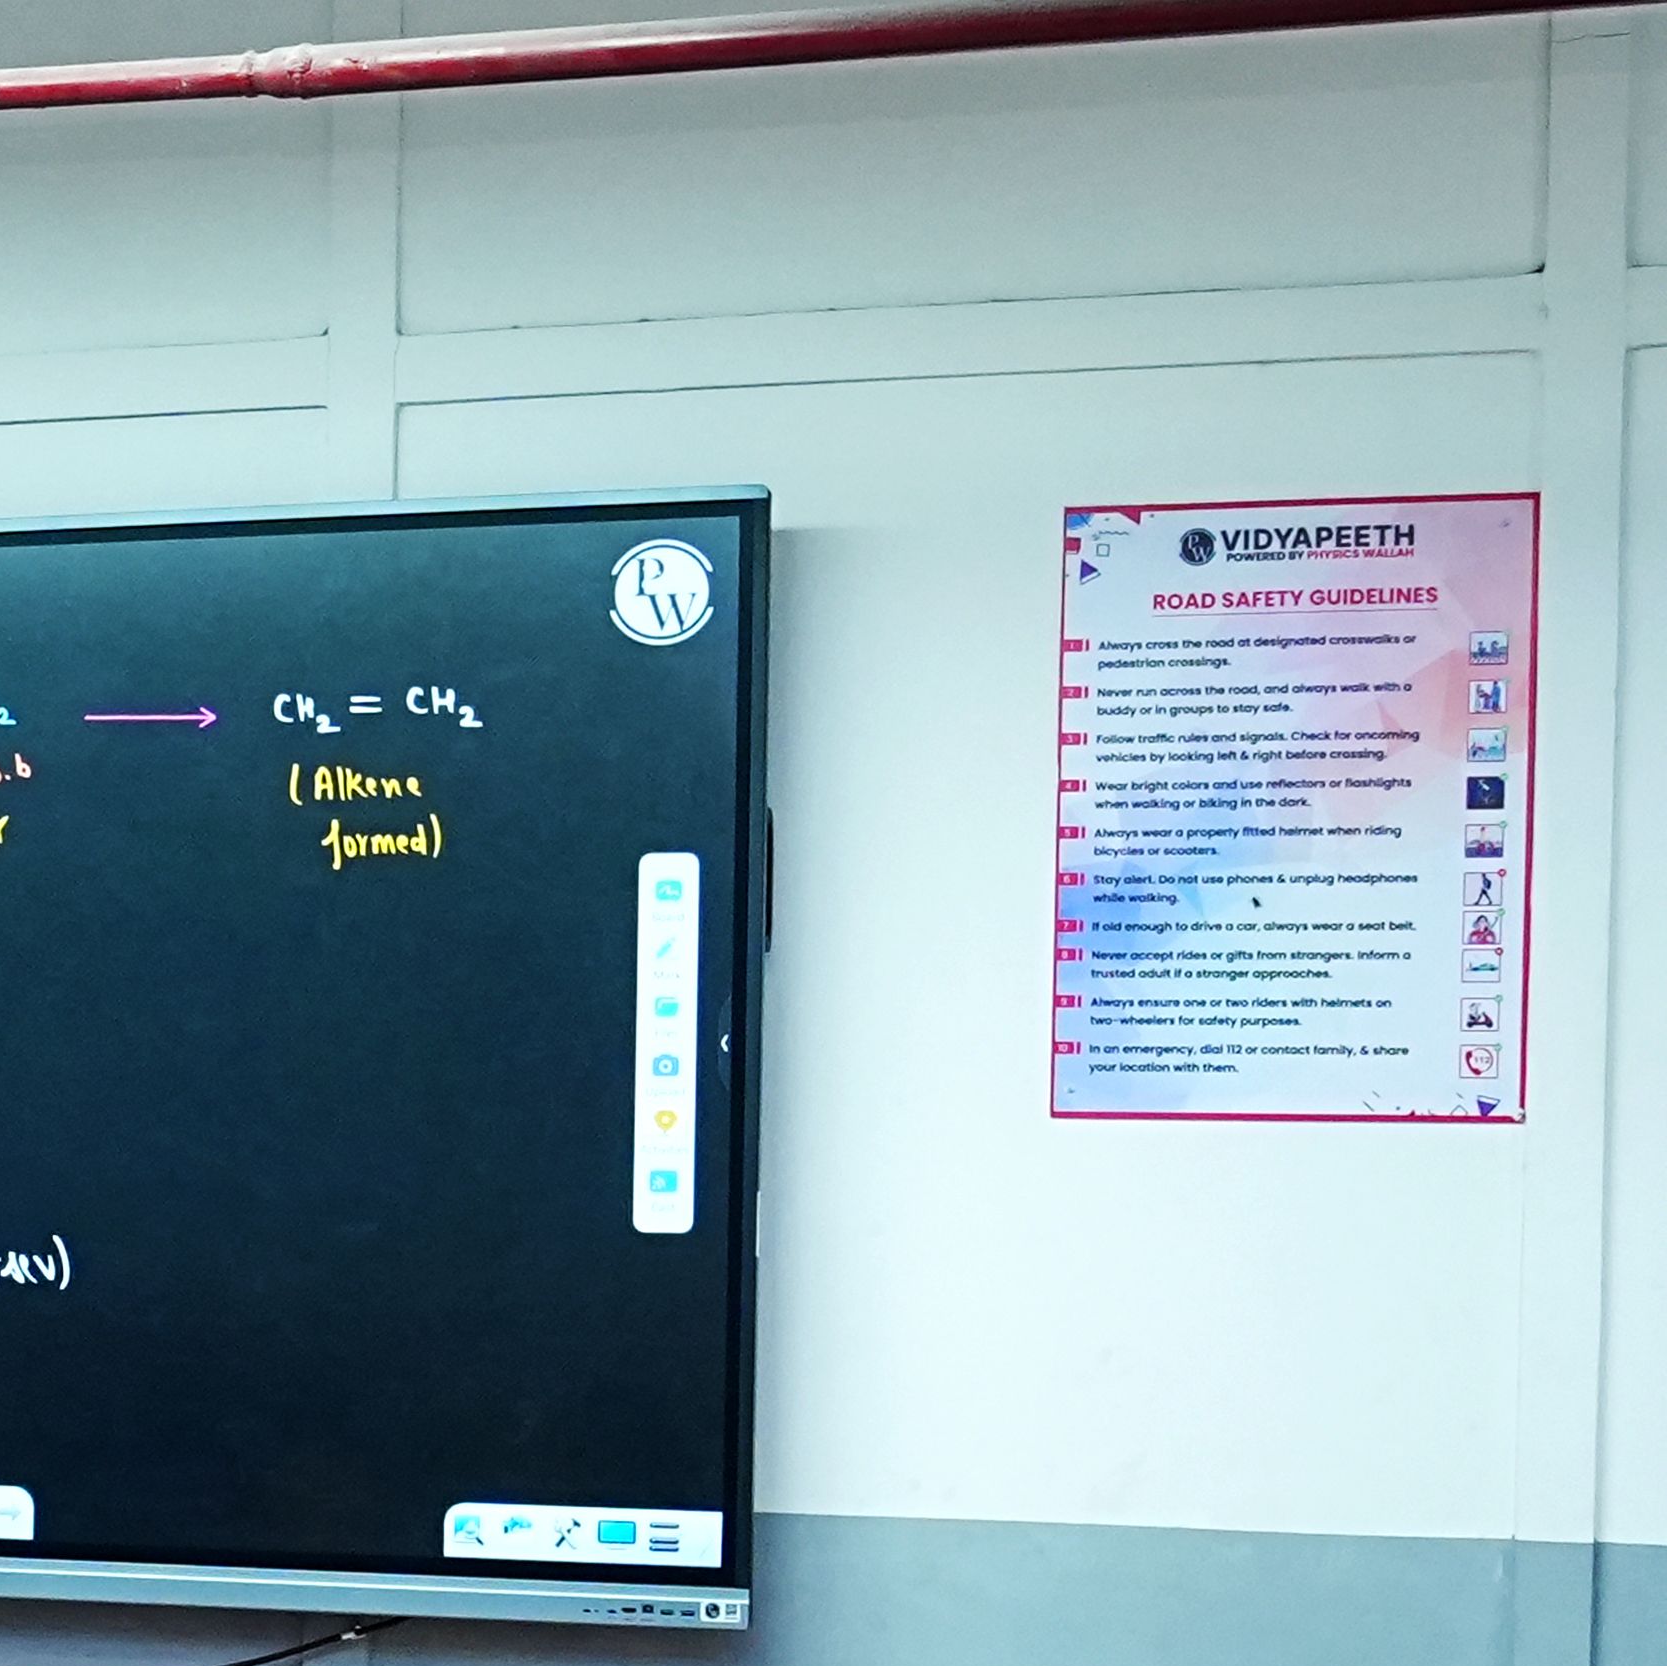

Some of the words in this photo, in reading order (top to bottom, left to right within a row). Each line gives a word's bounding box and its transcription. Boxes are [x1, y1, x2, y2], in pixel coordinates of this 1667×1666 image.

[1221, 524, 1414, 549] VIDYAPEETH
[1226, 552, 1285, 562] POWERED
[1289, 551, 1305, 560] BY
[1307, 550, 1359, 559] PHYSICS
[1362, 548, 1414, 558] WALLAH
[1153, 594, 1216, 609] ROAD
[1223, 591, 1303, 607] SAFETY
[1310, 588, 1438, 605] GUIDELINES
[1098, 687, 1132, 697] Never
[1160, 687, 1201, 696] across
[1205, 685, 1224, 695] the
[1264, 684, 1288, 694] and
[1292, 683, 1337, 695] always
[1341, 683, 1369, 692] walk
[1374, 683, 1400, 692] with
[1097, 734, 1135, 744] Follow
[1138, 733, 1175, 744] traffic
[1178, 733, 1208, 743] rules
[1212, 733, 1235, 742] and
[1292, 731, 1331, 741] Check
[1334, 730, 1351, 741] for
[1355, 730, 1420, 742] oncoming
[1090, 1045, 1101, 1055] In
[1104, 1047, 1119, 1055] an
[1201, 1045, 1222, 1055] dial
[1226, 1045, 1242, 1055] 112
[1245, 1047, 1258, 1055] or
[1261, 1046, 1309, 1055] contact
[1361, 1046, 1369, 1055] &
[1374, 1046, 1408, 1055] share
[1089, 1065, 1116, 1075] your
[1120, 1063, 1170, 1074] location
[1173, 1063, 1200, 1073] with
